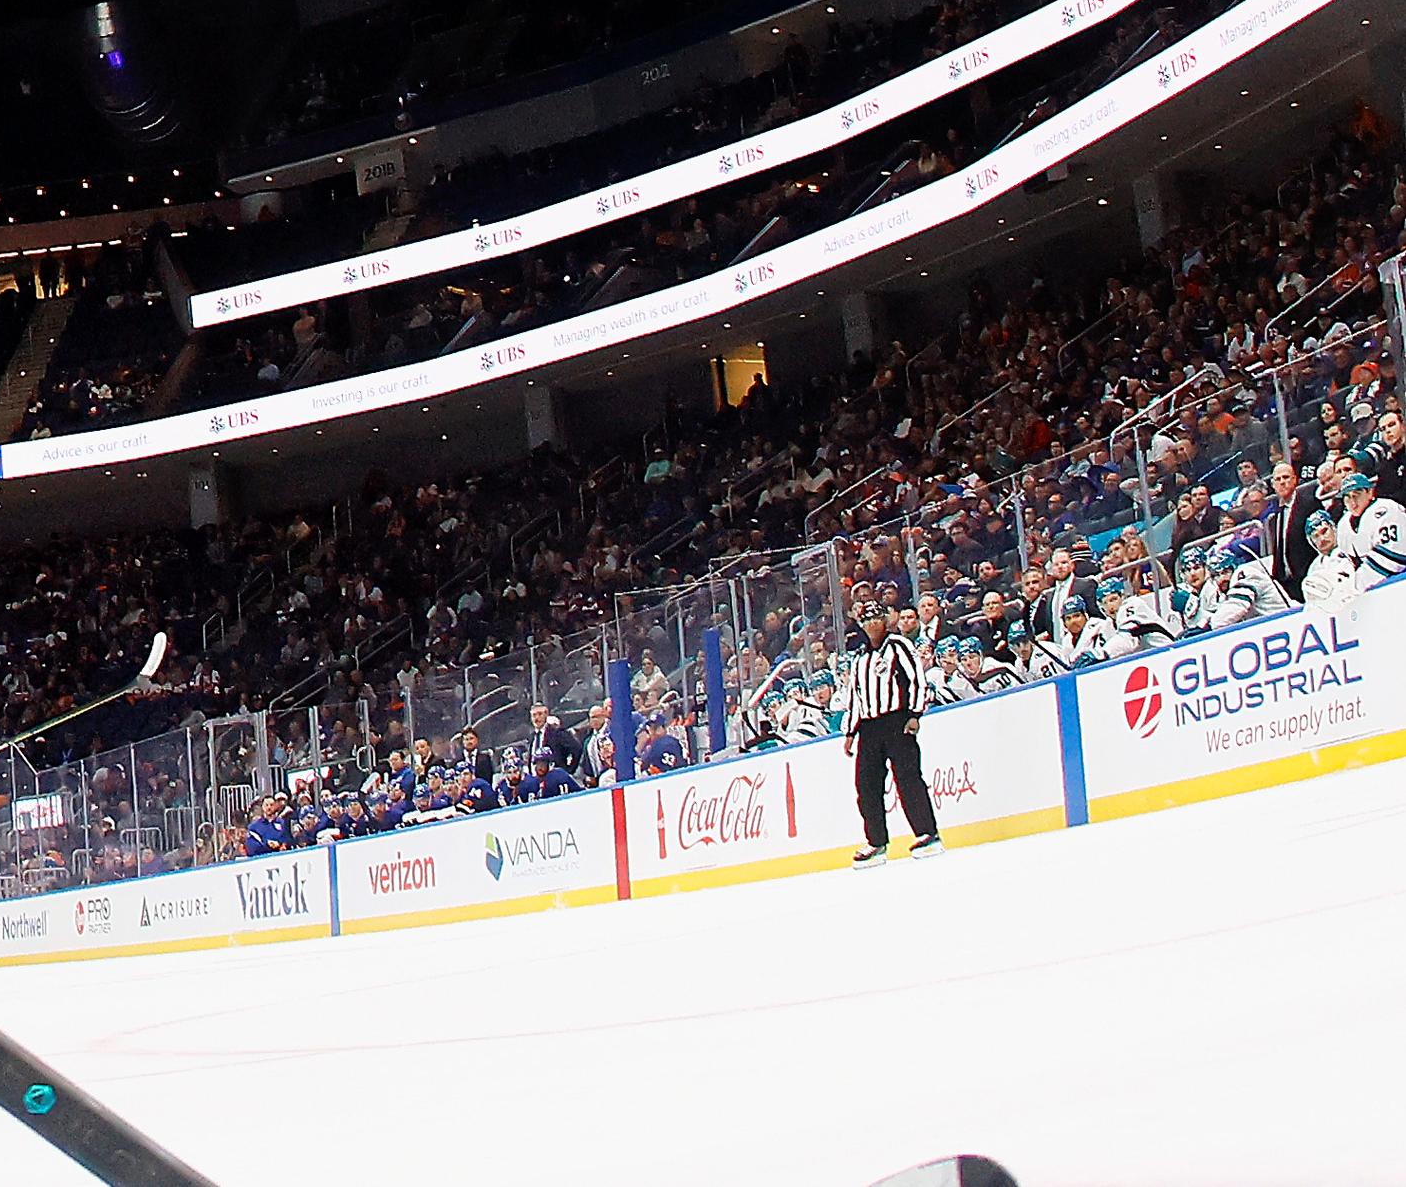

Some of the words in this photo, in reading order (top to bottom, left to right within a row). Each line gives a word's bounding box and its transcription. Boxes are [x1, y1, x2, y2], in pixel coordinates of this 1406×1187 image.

[961, 48, 989, 72] UBS
[1171, 49, 1197, 78] UBS
[855, 99, 880, 120] UBS
[735, 146, 765, 169] UBS
[976, 166, 1000, 193] UBS
[611, 188, 641, 209] UBS
[492, 227, 522, 247] UBS
[360, 259, 390, 278] UBS
[749, 262, 775, 286] UBS
[233, 291, 262, 308] UBS
[553, 320, 607, 347] Managing
[609, 309, 647, 331] wealth
[661, 300, 680, 316] our
[496, 343, 526, 365] UBS
[311, 389, 363, 410] Investing
[379, 382, 399, 396] our
[227, 410, 259, 429] UBS
[43, 444, 82, 462] Advice
[98, 440, 119, 452] our
[1379, 524, 1398, 544] 33
[1171, 616, 1360, 696] GLOBAL
[1174, 659, 1363, 727] INDUSTRIAL
[1206, 728, 1231, 753] We
[1235, 724, 1264, 747] can
[1269, 707, 1323, 742] supply
[1328, 696, 1367, 724] that.
[505, 828, 580, 866] VANDA
[368, 852, 436, 895] verizon
[236, 862, 310, 921] VanEck
[88, 898, 112, 919] PRO
[153, 896, 209, 923] ACRISURE
[2, 912, 48, 940] Northwell
